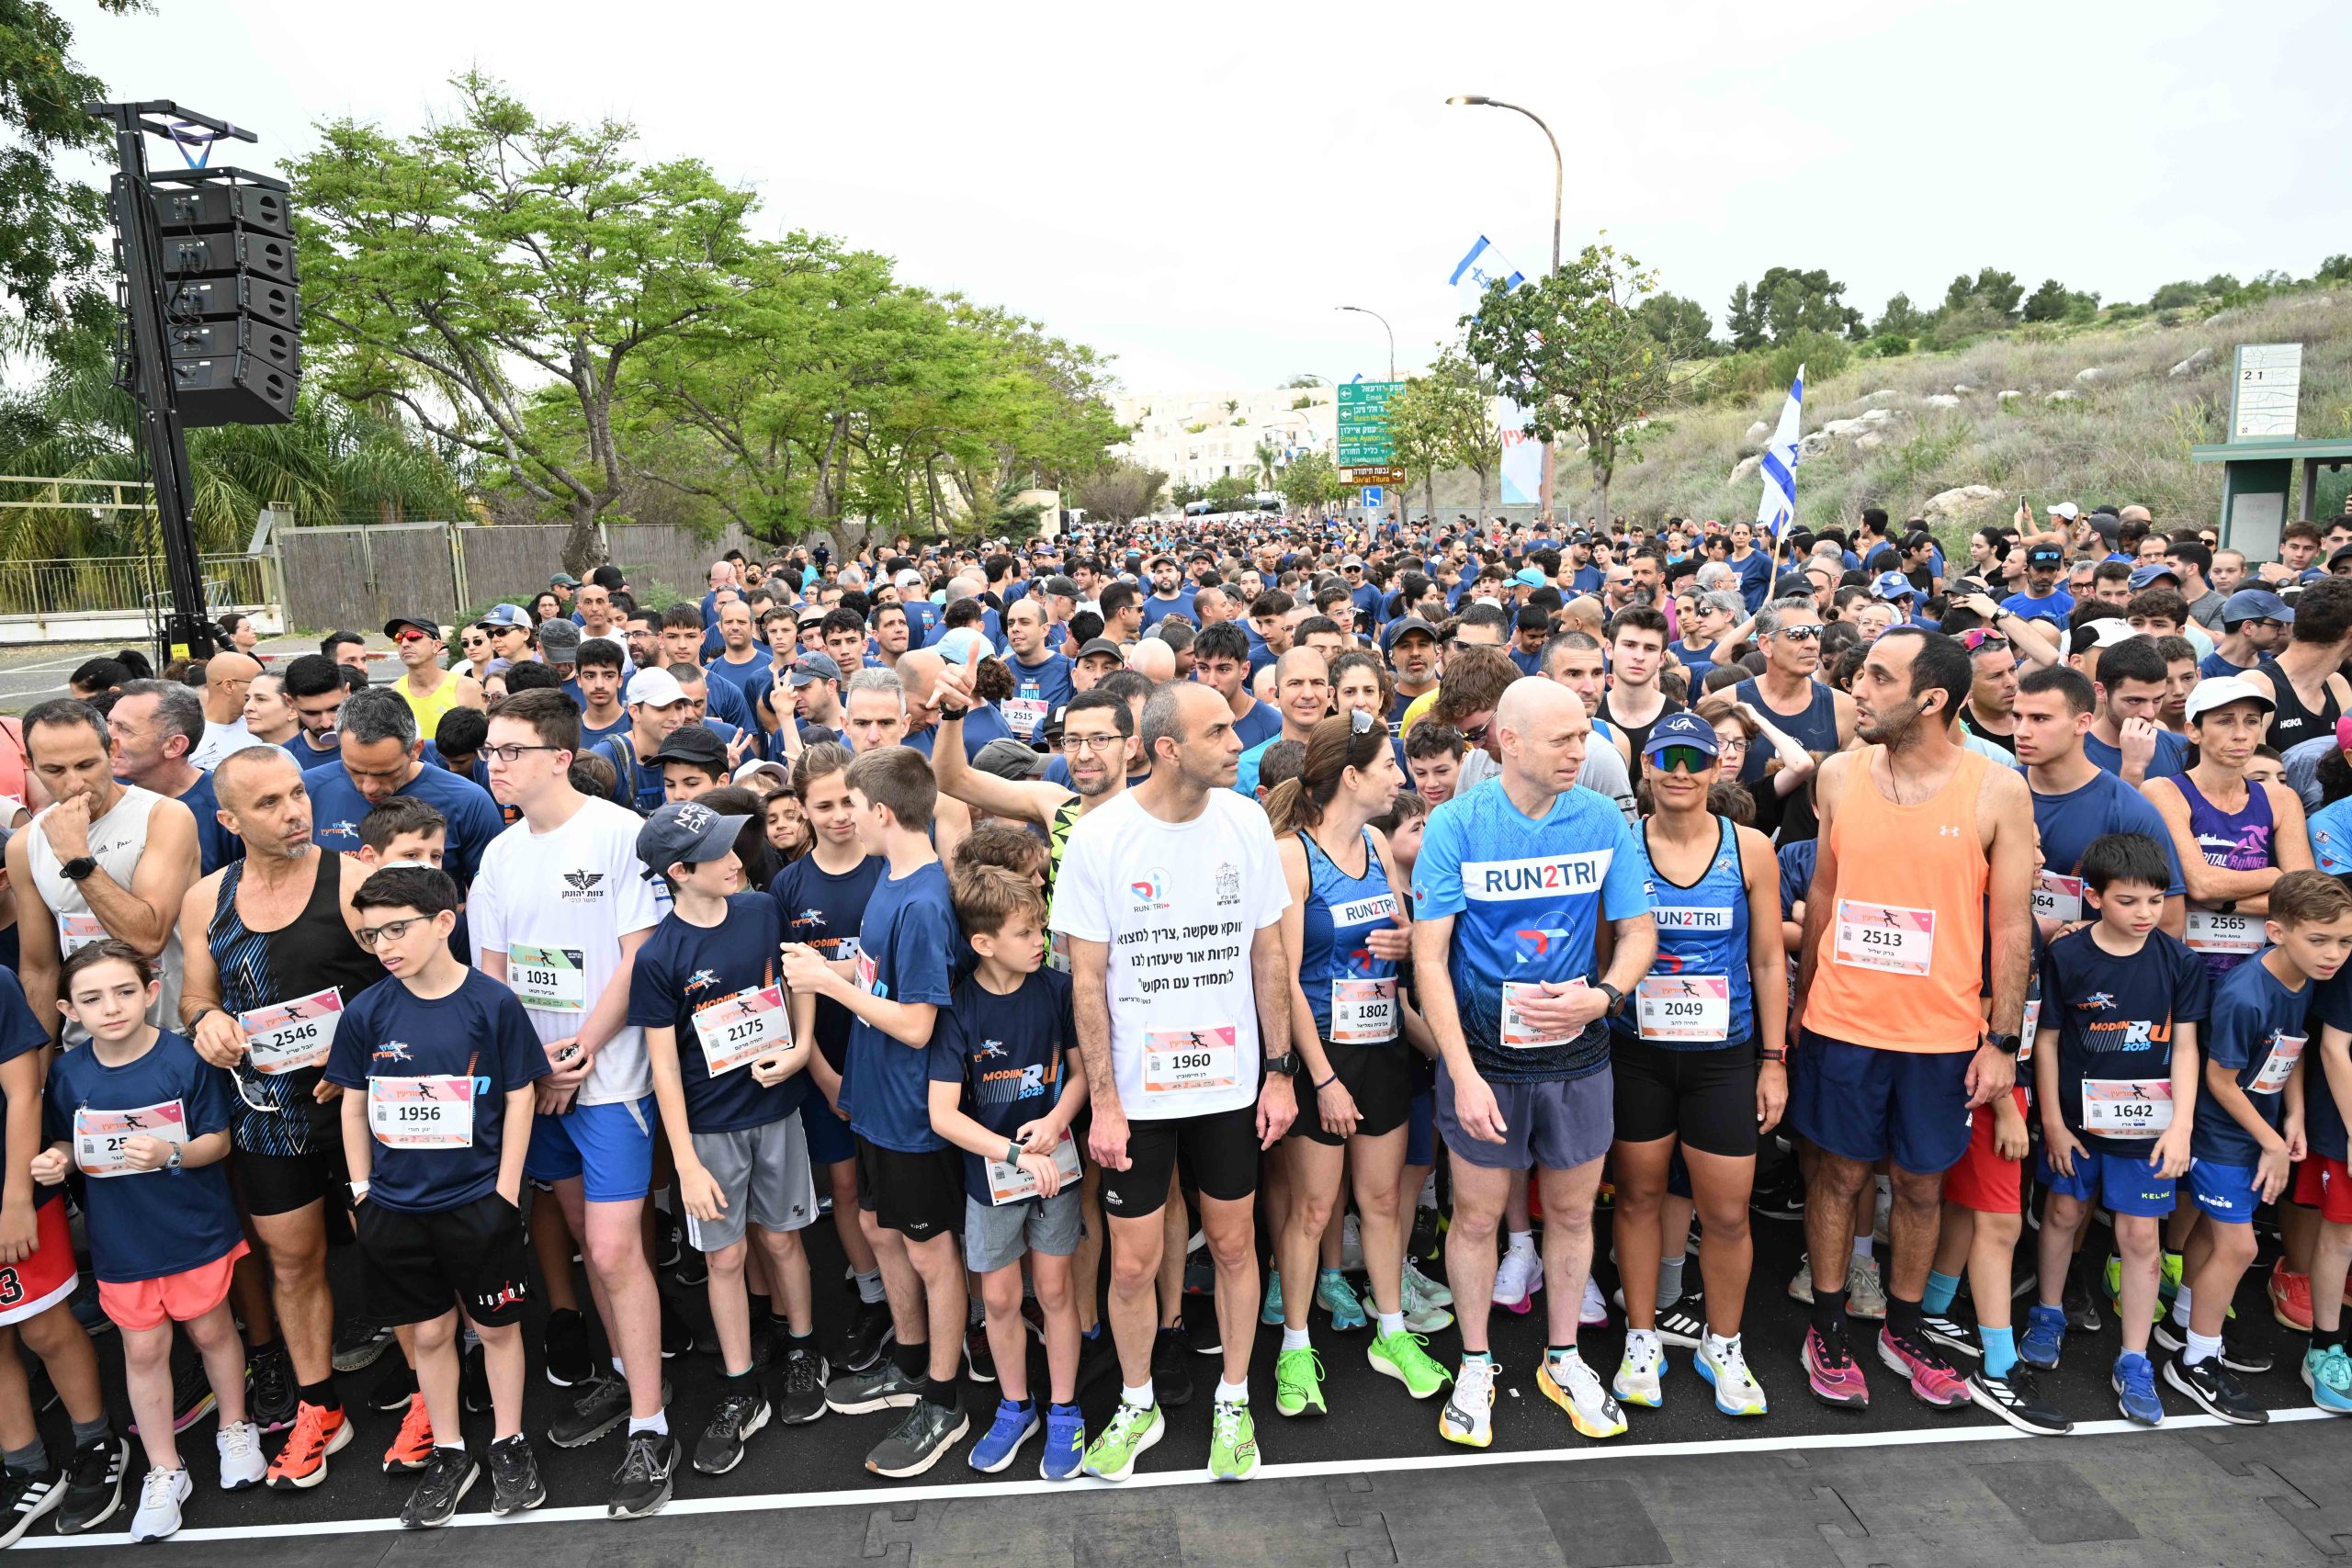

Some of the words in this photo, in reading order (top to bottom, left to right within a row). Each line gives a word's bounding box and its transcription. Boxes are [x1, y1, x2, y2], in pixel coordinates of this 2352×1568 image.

[1352, 476, 1371, 484] Giv'at
[1020, 690, 1040, 699] RUN
[1013, 712, 1033, 720] 2515
[1486, 861, 1597, 893] RUN2TRI
[561, 890, 584, 899] יהונתן
[1346, 898, 1396, 921] RUN2TRI
[2211, 917, 2245, 931] 2565
[1116, 928, 1149, 945] למצוא
[1182, 924, 1218, 940] שקשה
[1862, 930, 1903, 947] 2513
[1147, 953, 1183, 967] שיעזרו
[1186, 950, 1204, 963] אור
[526, 970, 559, 986] 1031
[1172, 976, 1190, 989] עם
[1359, 1003, 1388, 1019] 1802
[1665, 1002, 1703, 1016] 2049
[728, 1018, 763, 1043] 2175
[2089, 1021, 2131, 1032] MODIIN
[273, 1023, 318, 1047] 2546
[2122, 1042, 2152, 1052] 2025
[1172, 1054, 1211, 1069] 1960
[983, 1068, 1023, 1082] MODIIN
[1018, 1086, 1046, 1100] 2025
[399, 1107, 441, 1121] 1956
[2114, 1104, 2154, 1117] 1642
[2141, 1191, 2170, 1200] KELME
[479, 1281, 526, 1306] JORDA
